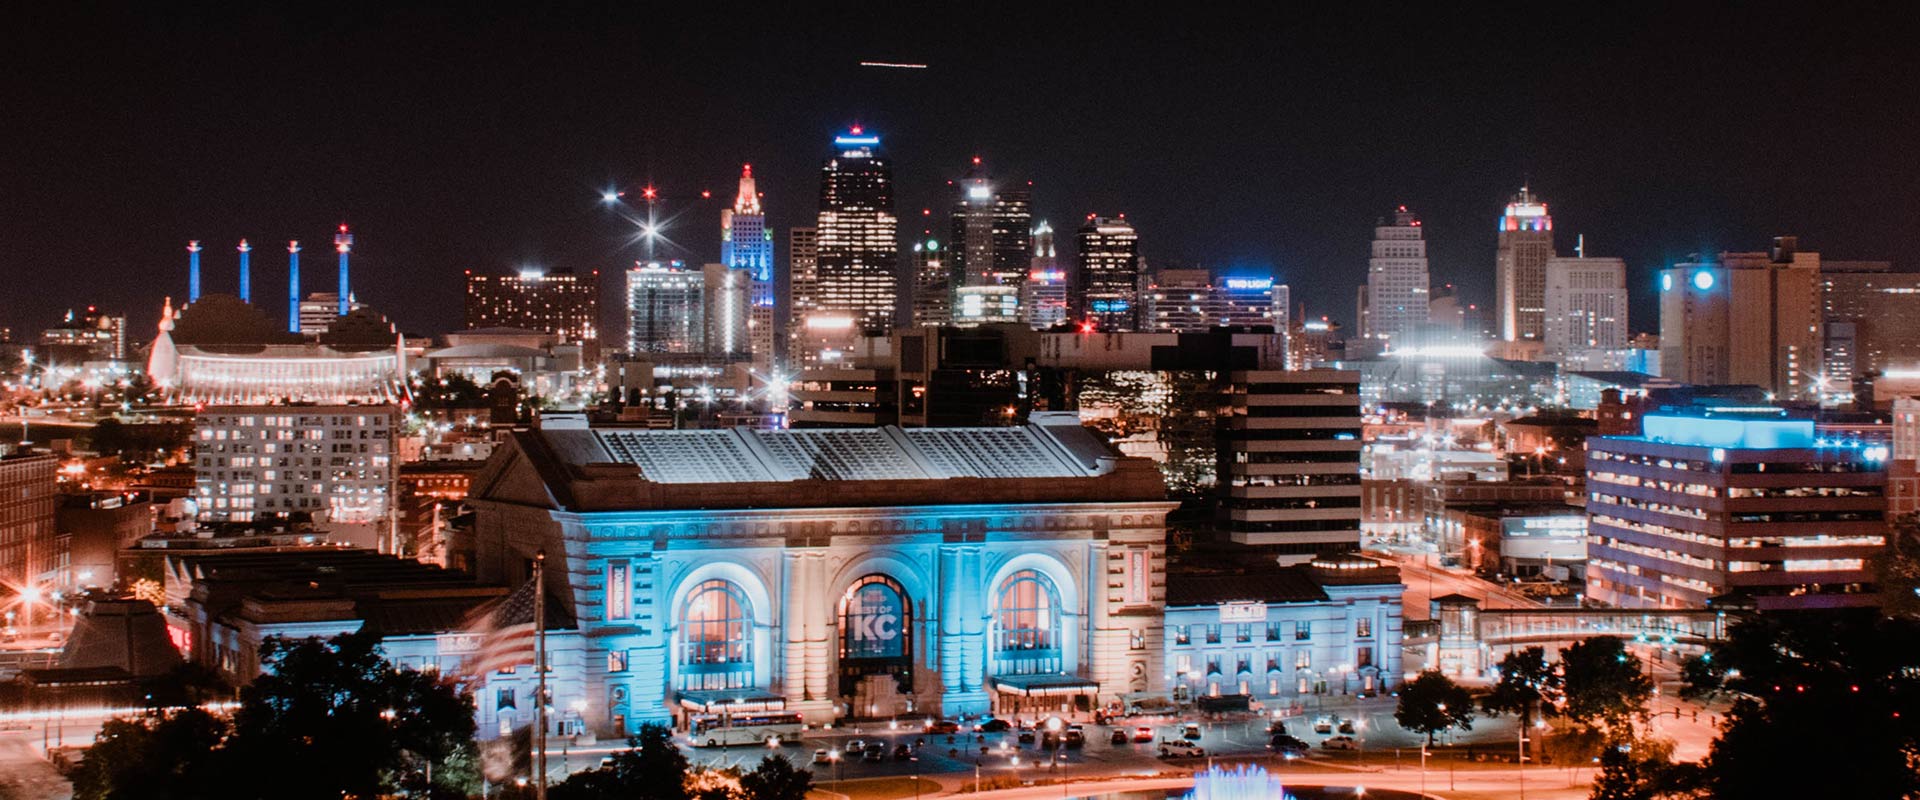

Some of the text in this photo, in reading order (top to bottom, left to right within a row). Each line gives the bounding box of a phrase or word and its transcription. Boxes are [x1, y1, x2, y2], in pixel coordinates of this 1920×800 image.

[1248, 280, 1272, 288] LIGHT
[879, 606, 893, 614] OF
[854, 614, 897, 640] KC
